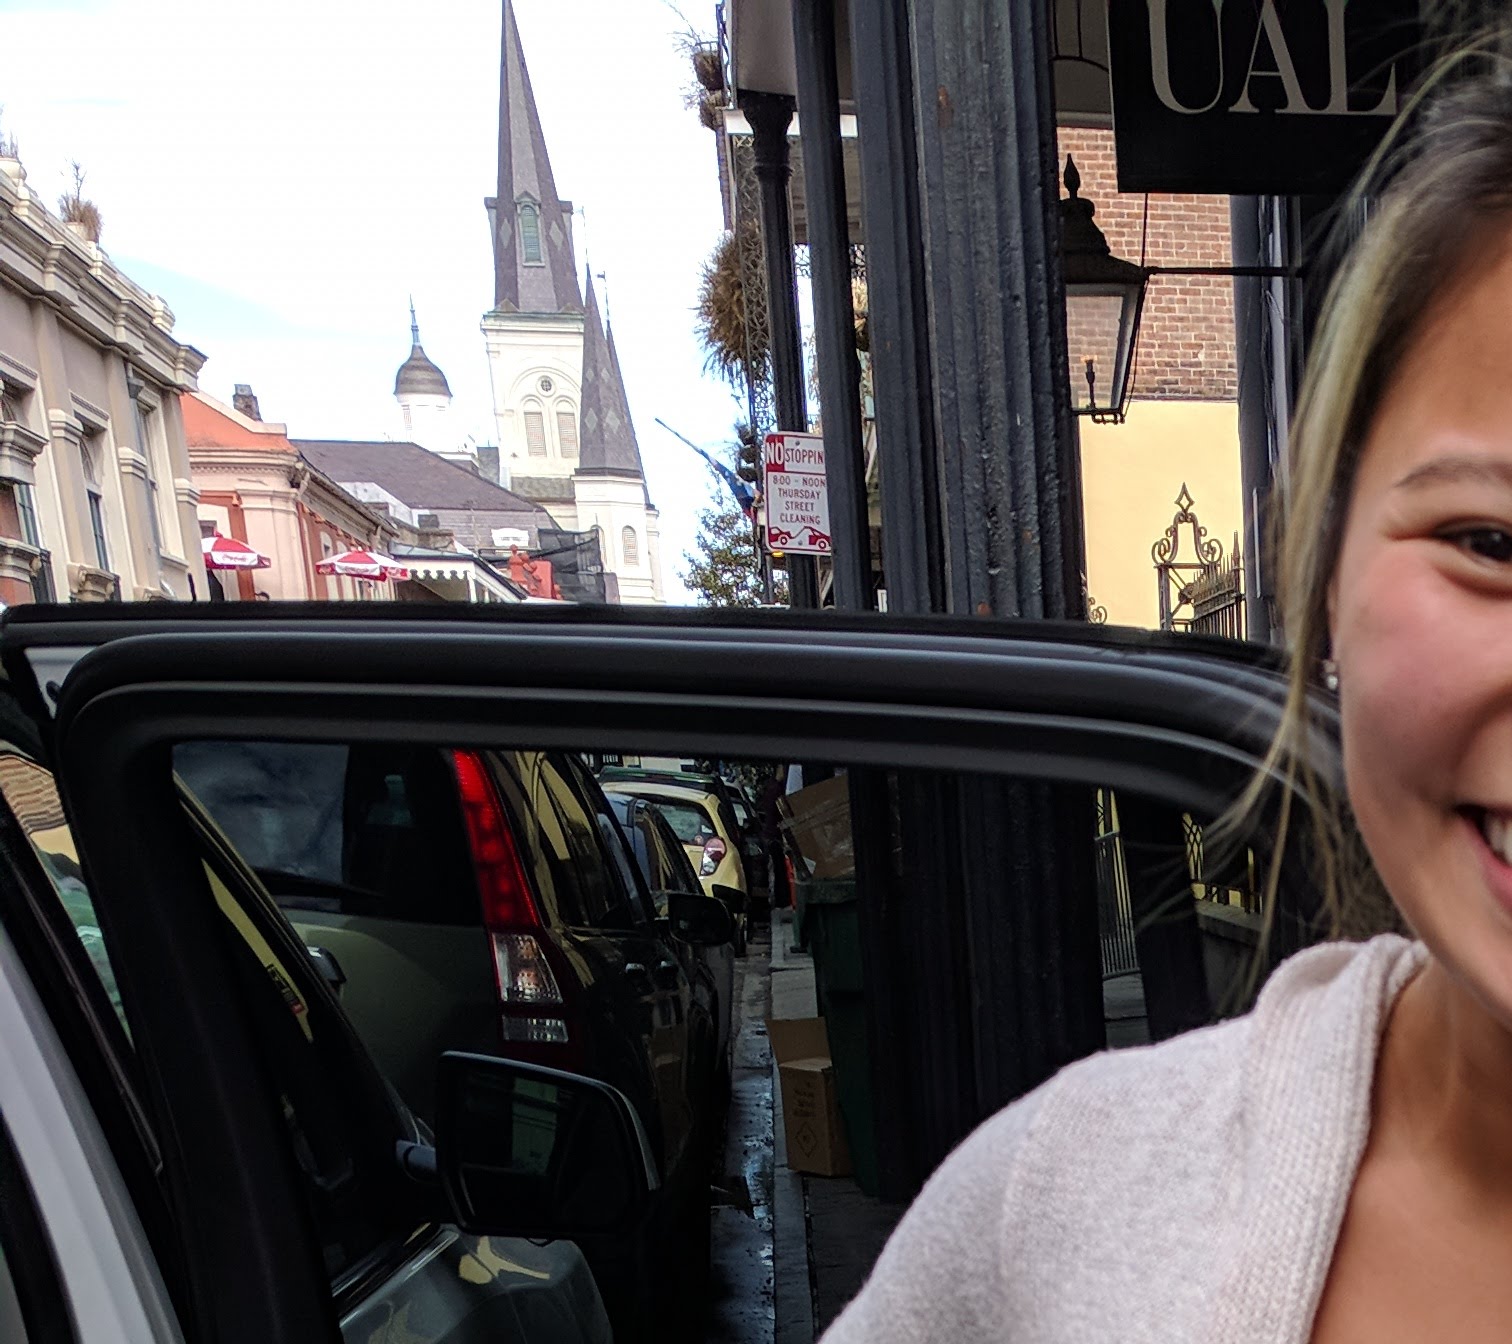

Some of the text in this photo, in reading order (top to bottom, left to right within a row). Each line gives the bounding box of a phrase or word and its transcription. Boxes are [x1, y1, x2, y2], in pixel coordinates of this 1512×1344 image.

[766, 442, 824, 465] NO STOPPIN
[802, 477, 826, 488] NOON
[778, 488, 821, 500] THURSDAY
[785, 501, 815, 512] STREET
[780, 512, 821, 525] CLEANING
